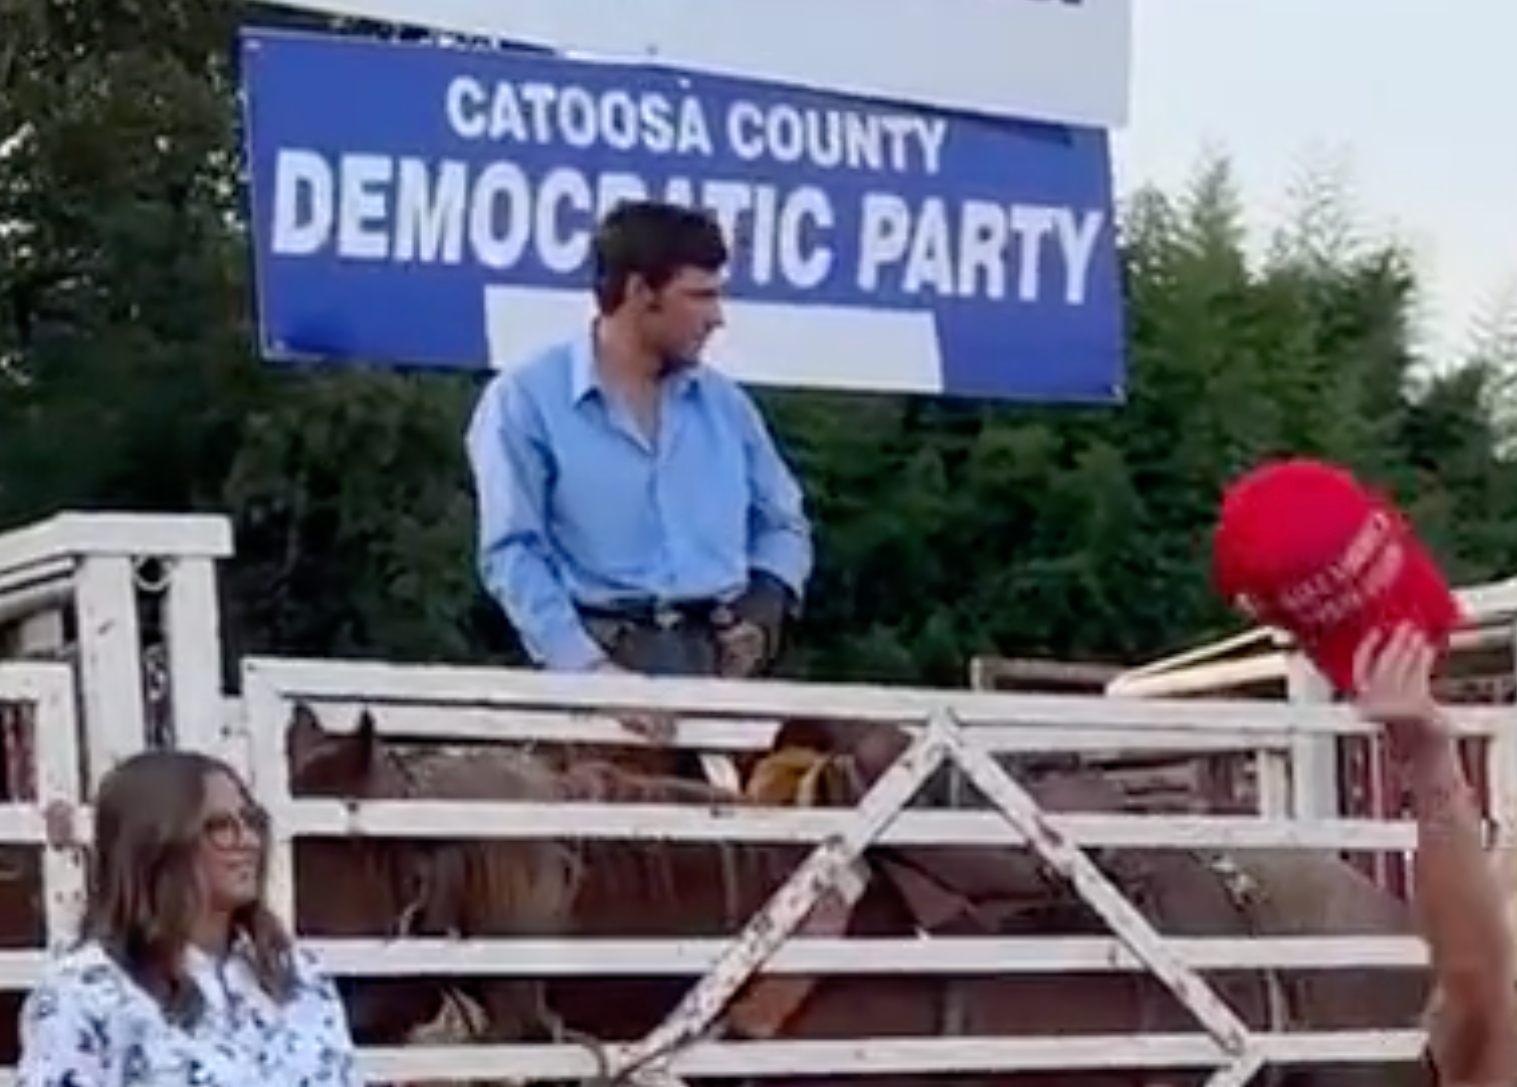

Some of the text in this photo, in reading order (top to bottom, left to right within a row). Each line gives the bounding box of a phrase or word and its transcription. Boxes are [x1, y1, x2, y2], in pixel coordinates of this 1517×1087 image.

[446, 77, 947, 173] CATOOSA COUNTY
[271, 149, 1104, 304] DEMOCTIC PARTY
